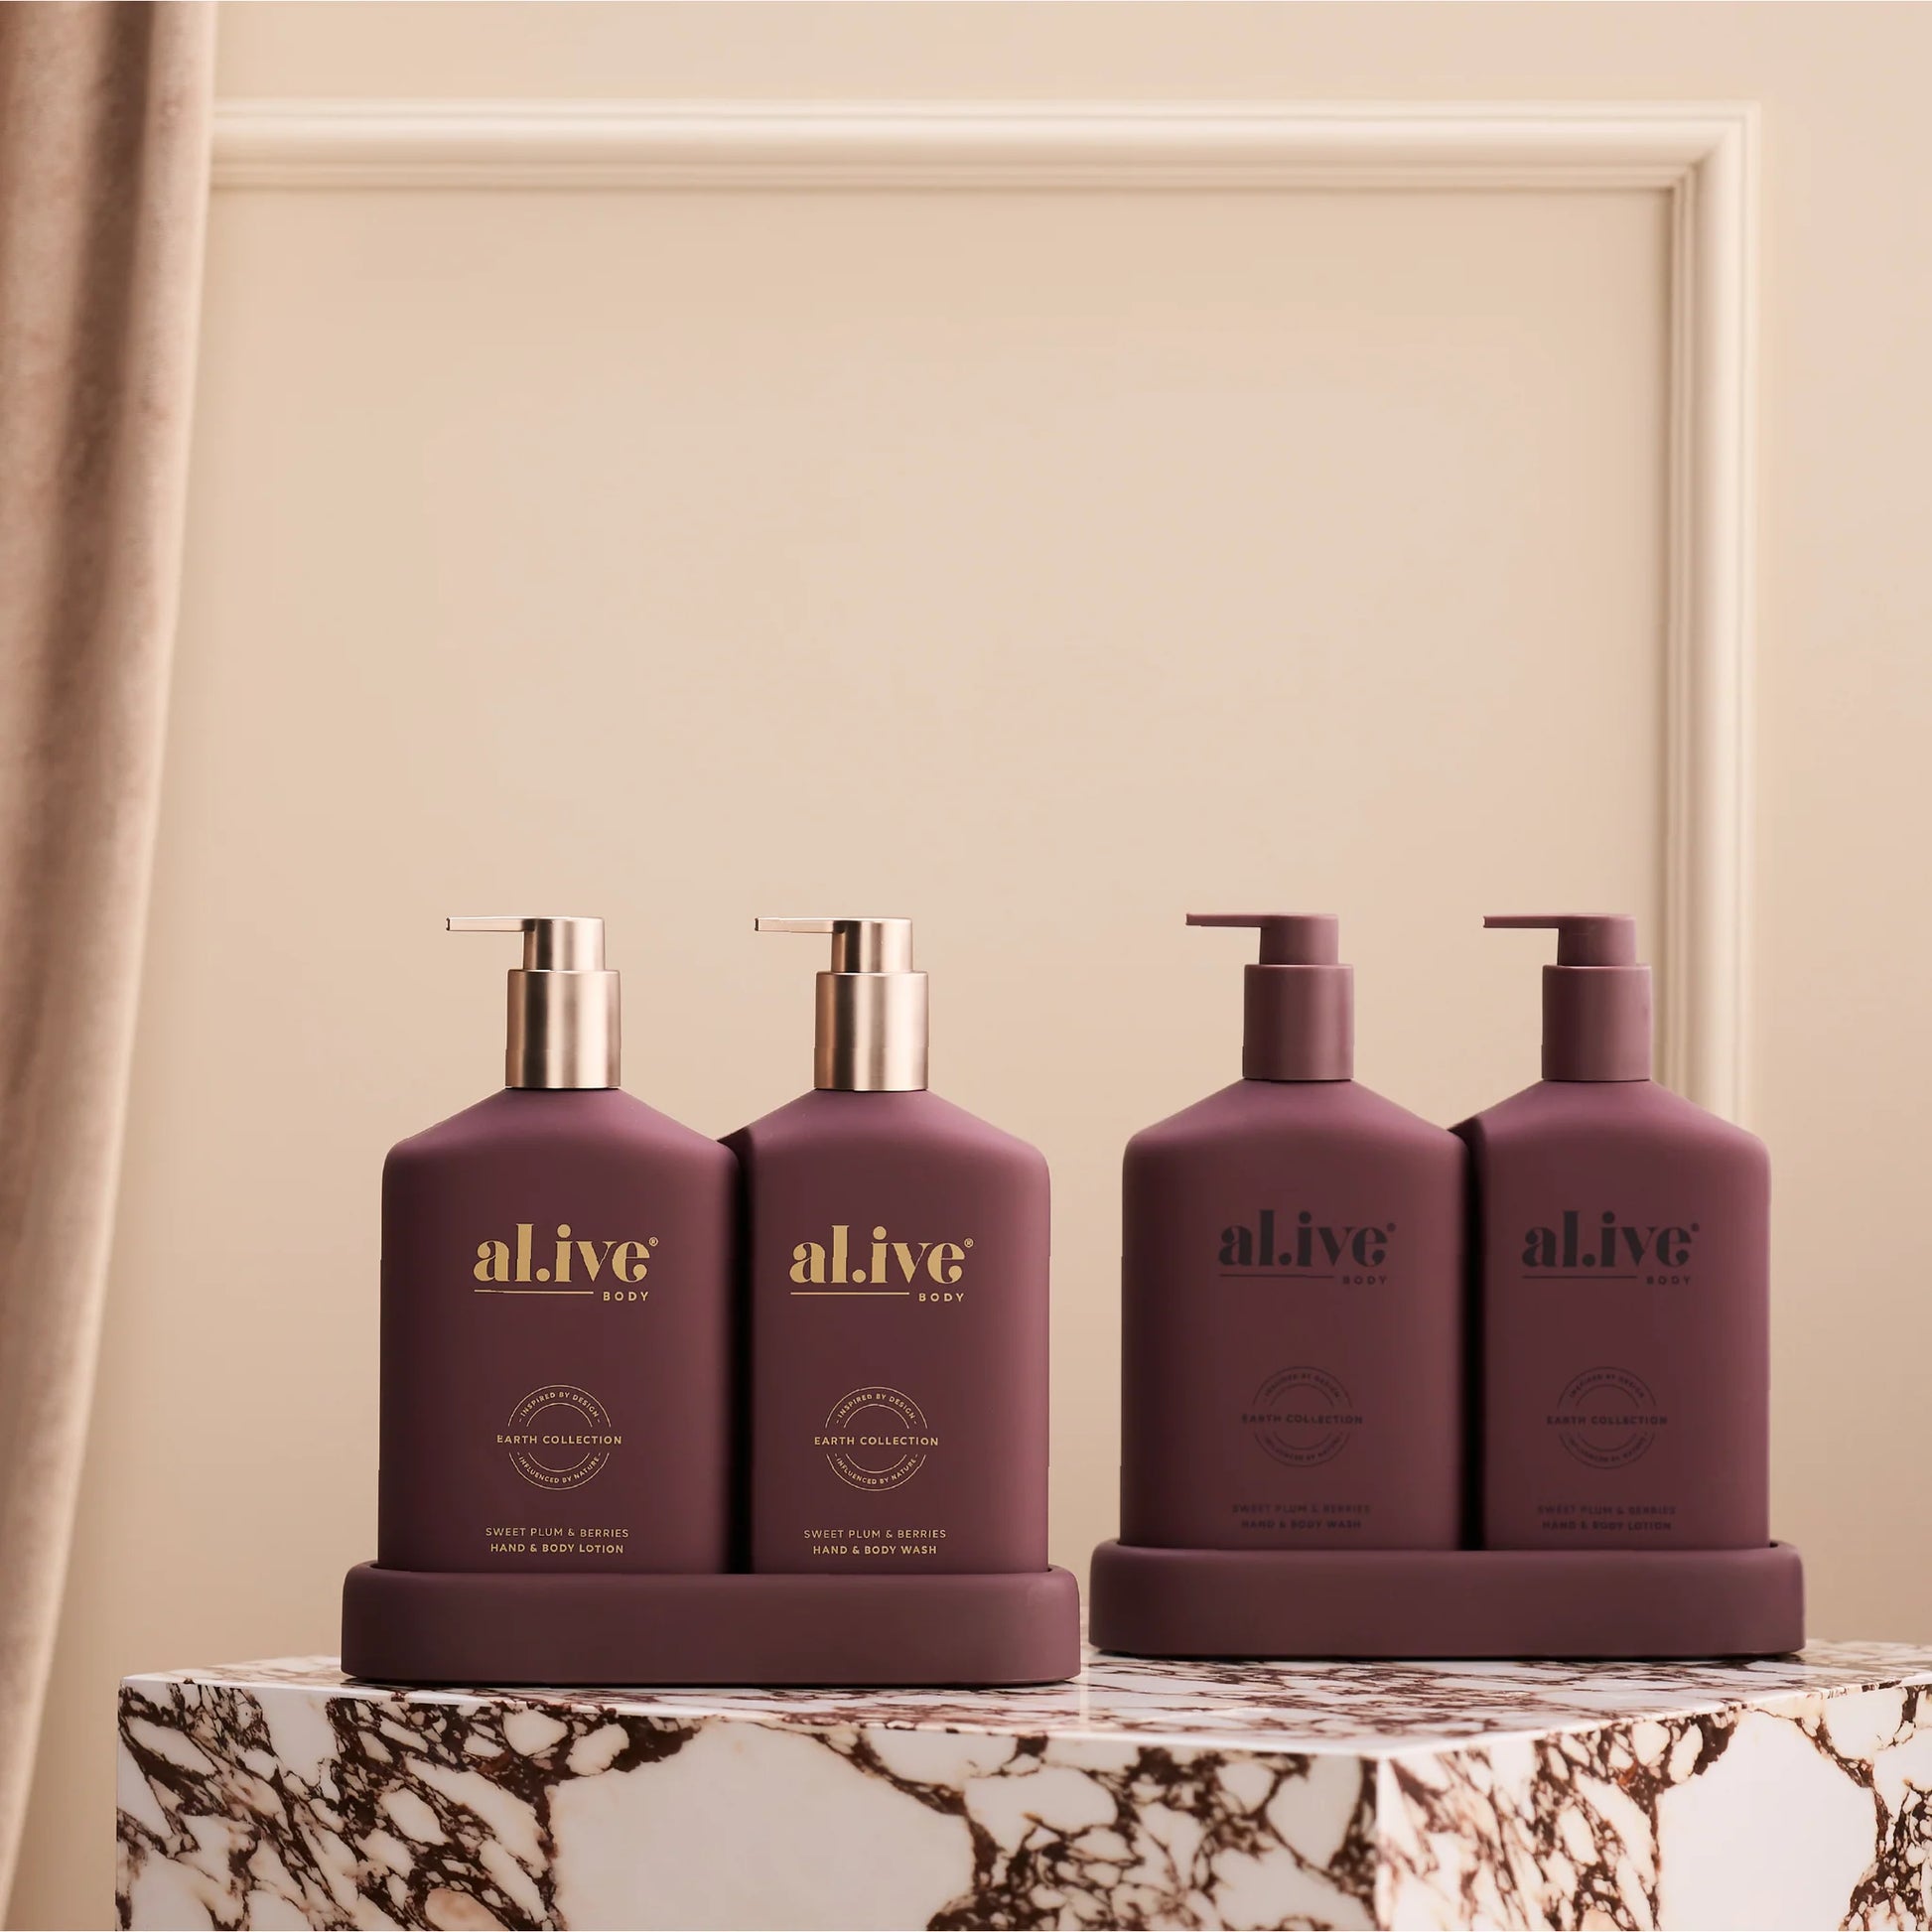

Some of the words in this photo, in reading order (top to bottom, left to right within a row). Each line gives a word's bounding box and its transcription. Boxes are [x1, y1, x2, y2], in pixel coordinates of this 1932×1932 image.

[1342, 1275, 1387, 1285] BODY
[1646, 1275, 1691, 1285] BODY
[603, 1291, 649, 1302] BODY
[918, 1293, 964, 1303] BODY
[520, 1392, 556, 1417] INSPIRED
[572, 1394, 600, 1418] DESIGN
[837, 1394, 873, 1419] INSPIRED
[889, 1396, 916, 1420] DESIGN
[1241, 1414, 1282, 1424] EARTH
[1286, 1414, 1363, 1424] COLLECTION
[1546, 1416, 1587, 1425] EARTH
[1590, 1416, 1668, 1425] COLLECTION
[496, 1435, 538, 1444] EARTH
[542, 1435, 622, 1445] COLLECTION
[814, 1437, 855, 1446] EARTH
[860, 1437, 938, 1447] COLLECTION
[518, 1456, 560, 1483] INFLUENCED
[574, 1456, 600, 1479] NATURE
[836, 1457, 877, 1485] INFLUENCED
[891, 1458, 917, 1481] NATURE
[485, 1527, 526, 1536] SWEET
[530, 1528, 563, 1537] PLUM
[567, 1528, 575, 1537] &
[580, 1528, 628, 1538] BERRIES
[803, 1530, 844, 1539] SWEET
[848, 1530, 881, 1539] PLUM
[886, 1530, 894, 1539] &
[897, 1530, 946, 1539] BERRIES
[490, 1543, 525, 1553] HAND
[530, 1544, 538, 1553] &
[542, 1544, 575, 1553] BODY
[579, 1544, 623, 1554] LOTION
[813, 1546, 848, 1555] HAND
[852, 1546, 860, 1555] &
[864, 1546, 897, 1555] BODY
[901, 1546, 937, 1555] WASH
